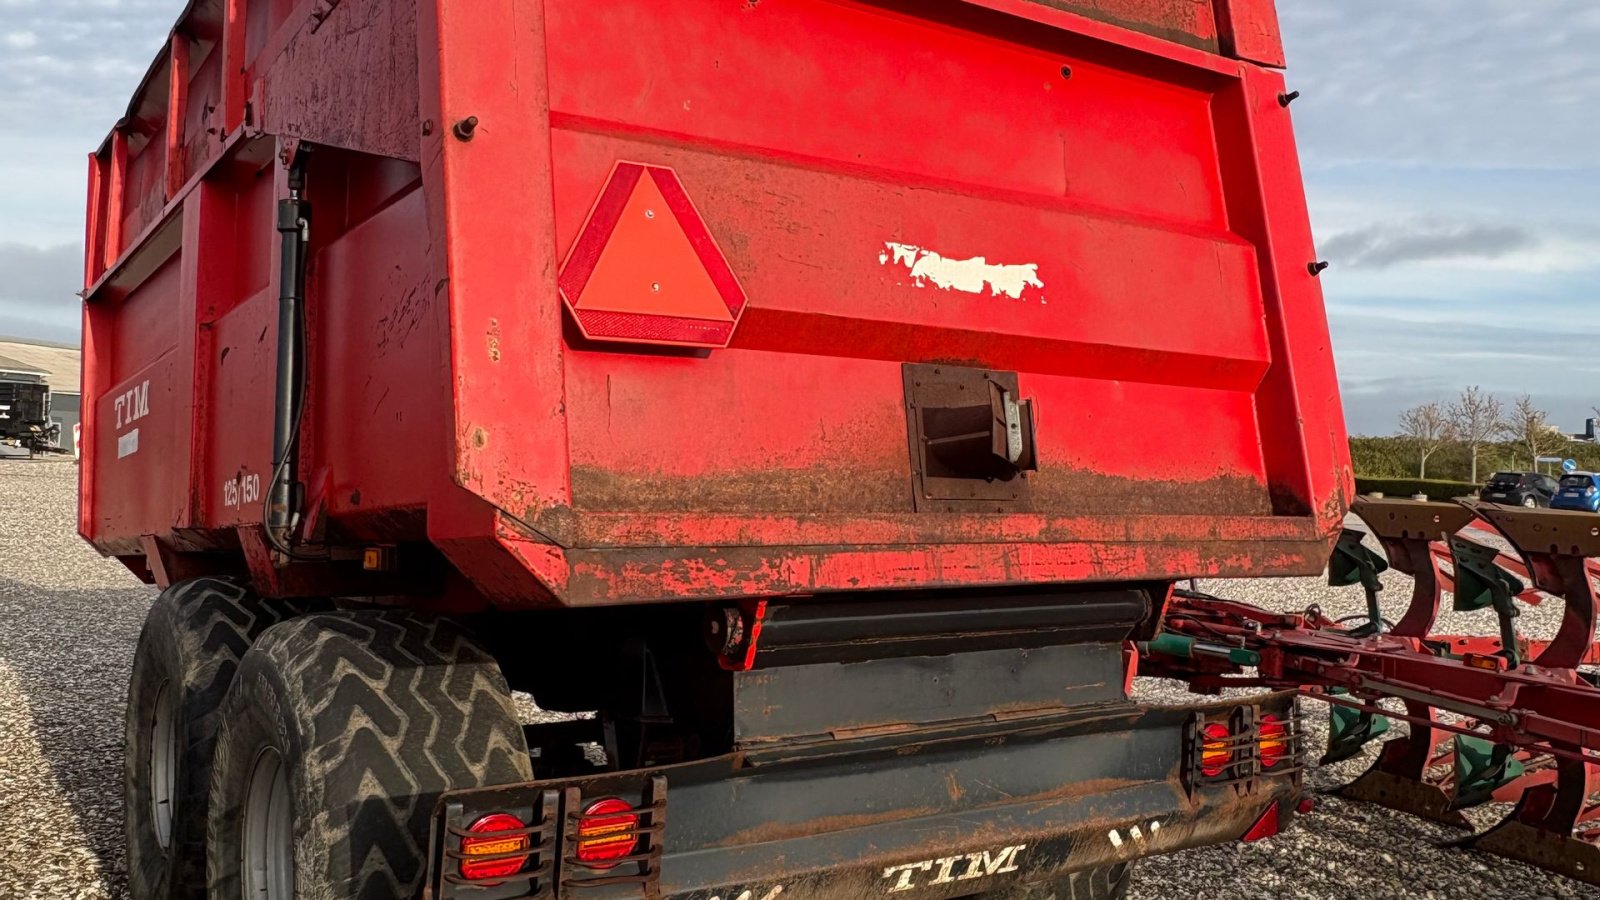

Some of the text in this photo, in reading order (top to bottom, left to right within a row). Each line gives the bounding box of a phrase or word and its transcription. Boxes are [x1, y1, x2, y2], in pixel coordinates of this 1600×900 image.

[114, 379, 150, 430] TIM
[223, 473, 260, 511] 125/150
[881, 844, 1027, 893] TIM
